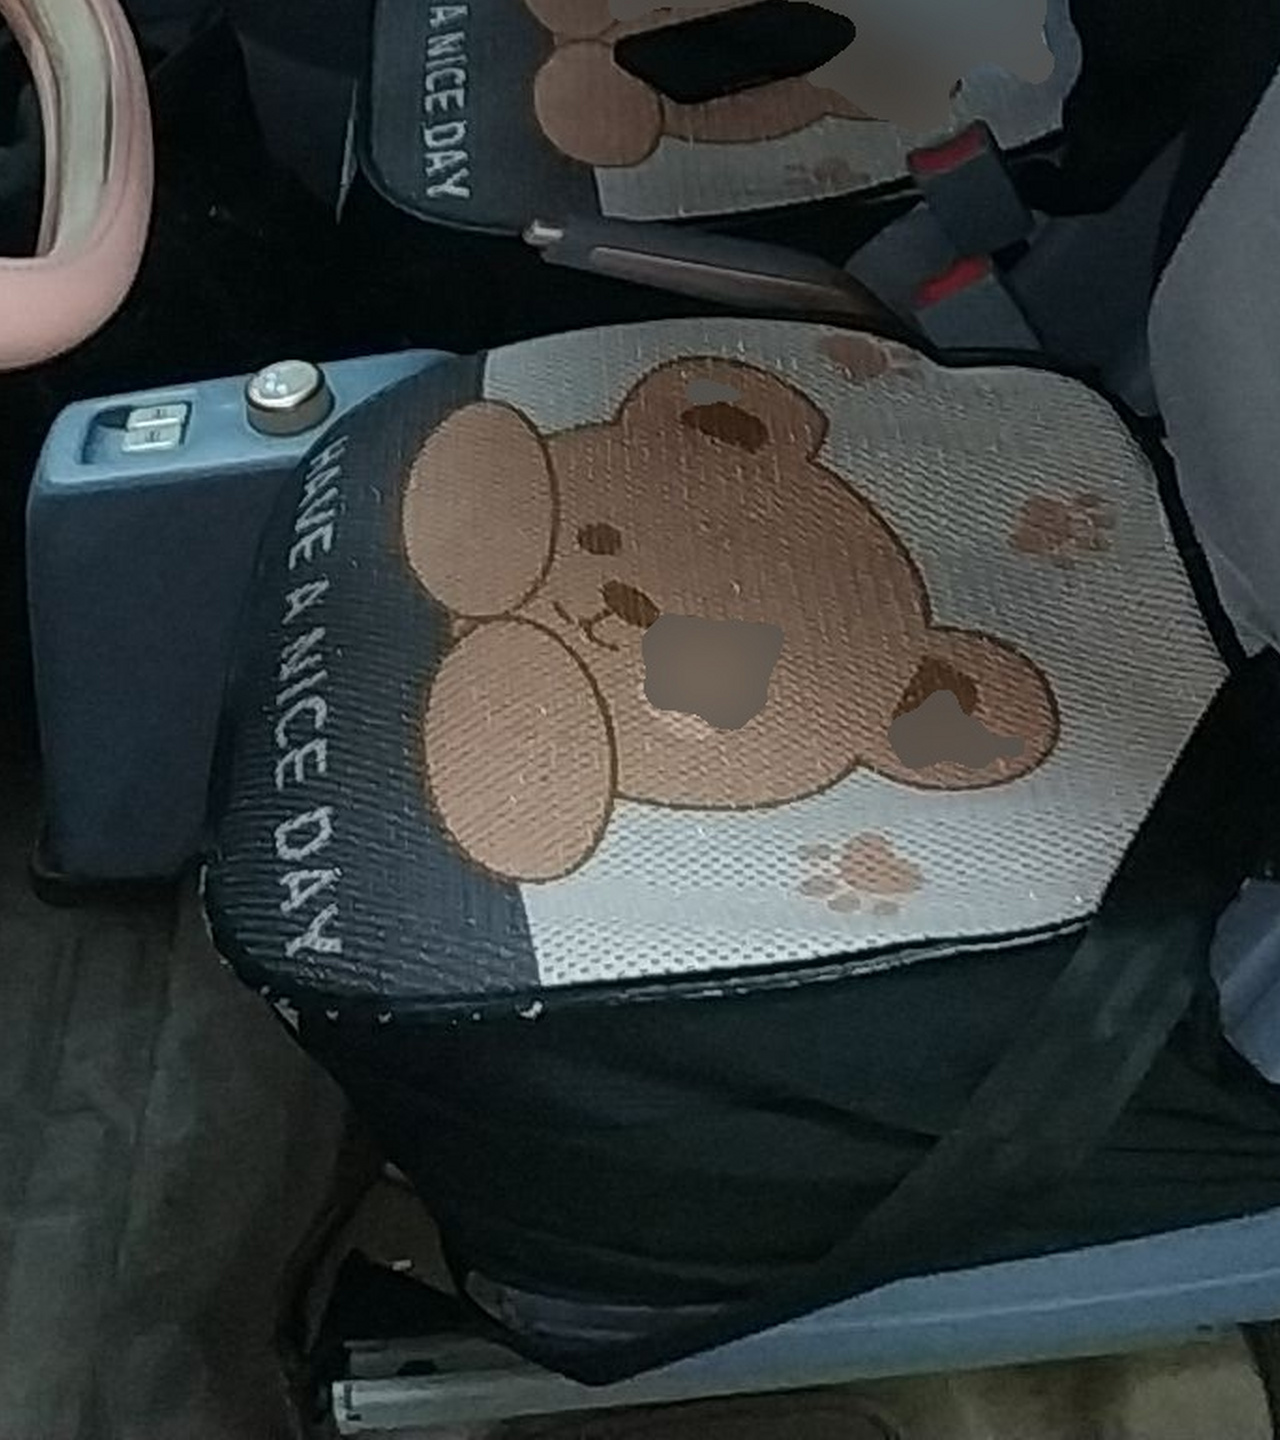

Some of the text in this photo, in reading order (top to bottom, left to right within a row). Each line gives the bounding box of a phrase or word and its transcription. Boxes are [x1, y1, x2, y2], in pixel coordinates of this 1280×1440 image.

[429, 6, 469, 29] A
[424, 32, 467, 112] NICE
[423, 120, 471, 198] DAY
[274, 436, 349, 959] HAVE A NICE DAY
